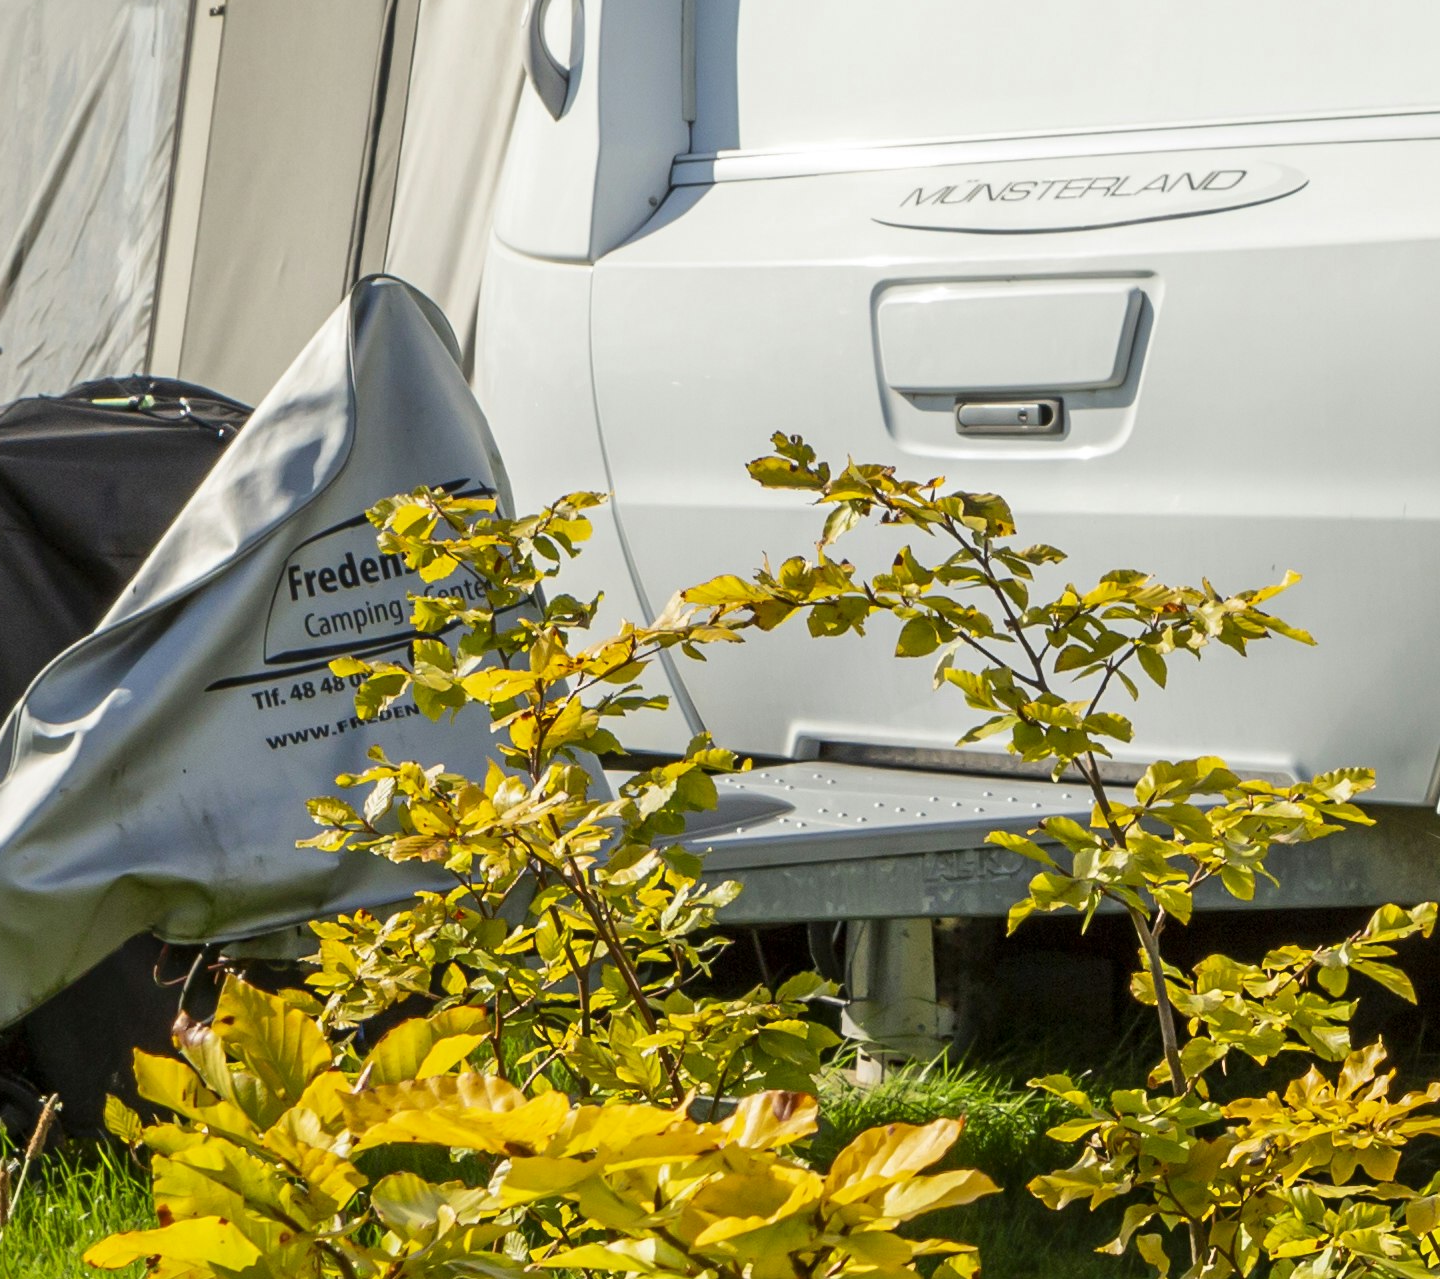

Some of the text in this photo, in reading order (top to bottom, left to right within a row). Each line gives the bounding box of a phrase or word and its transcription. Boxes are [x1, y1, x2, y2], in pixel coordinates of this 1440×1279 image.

[899, 169, 1248, 208] MÜNSTERLAND
[304, 598, 404, 638] Camping
[251, 687, 286, 710] Tlf.
[290, 681, 316, 701] 48
[320, 676, 345, 695] 48
